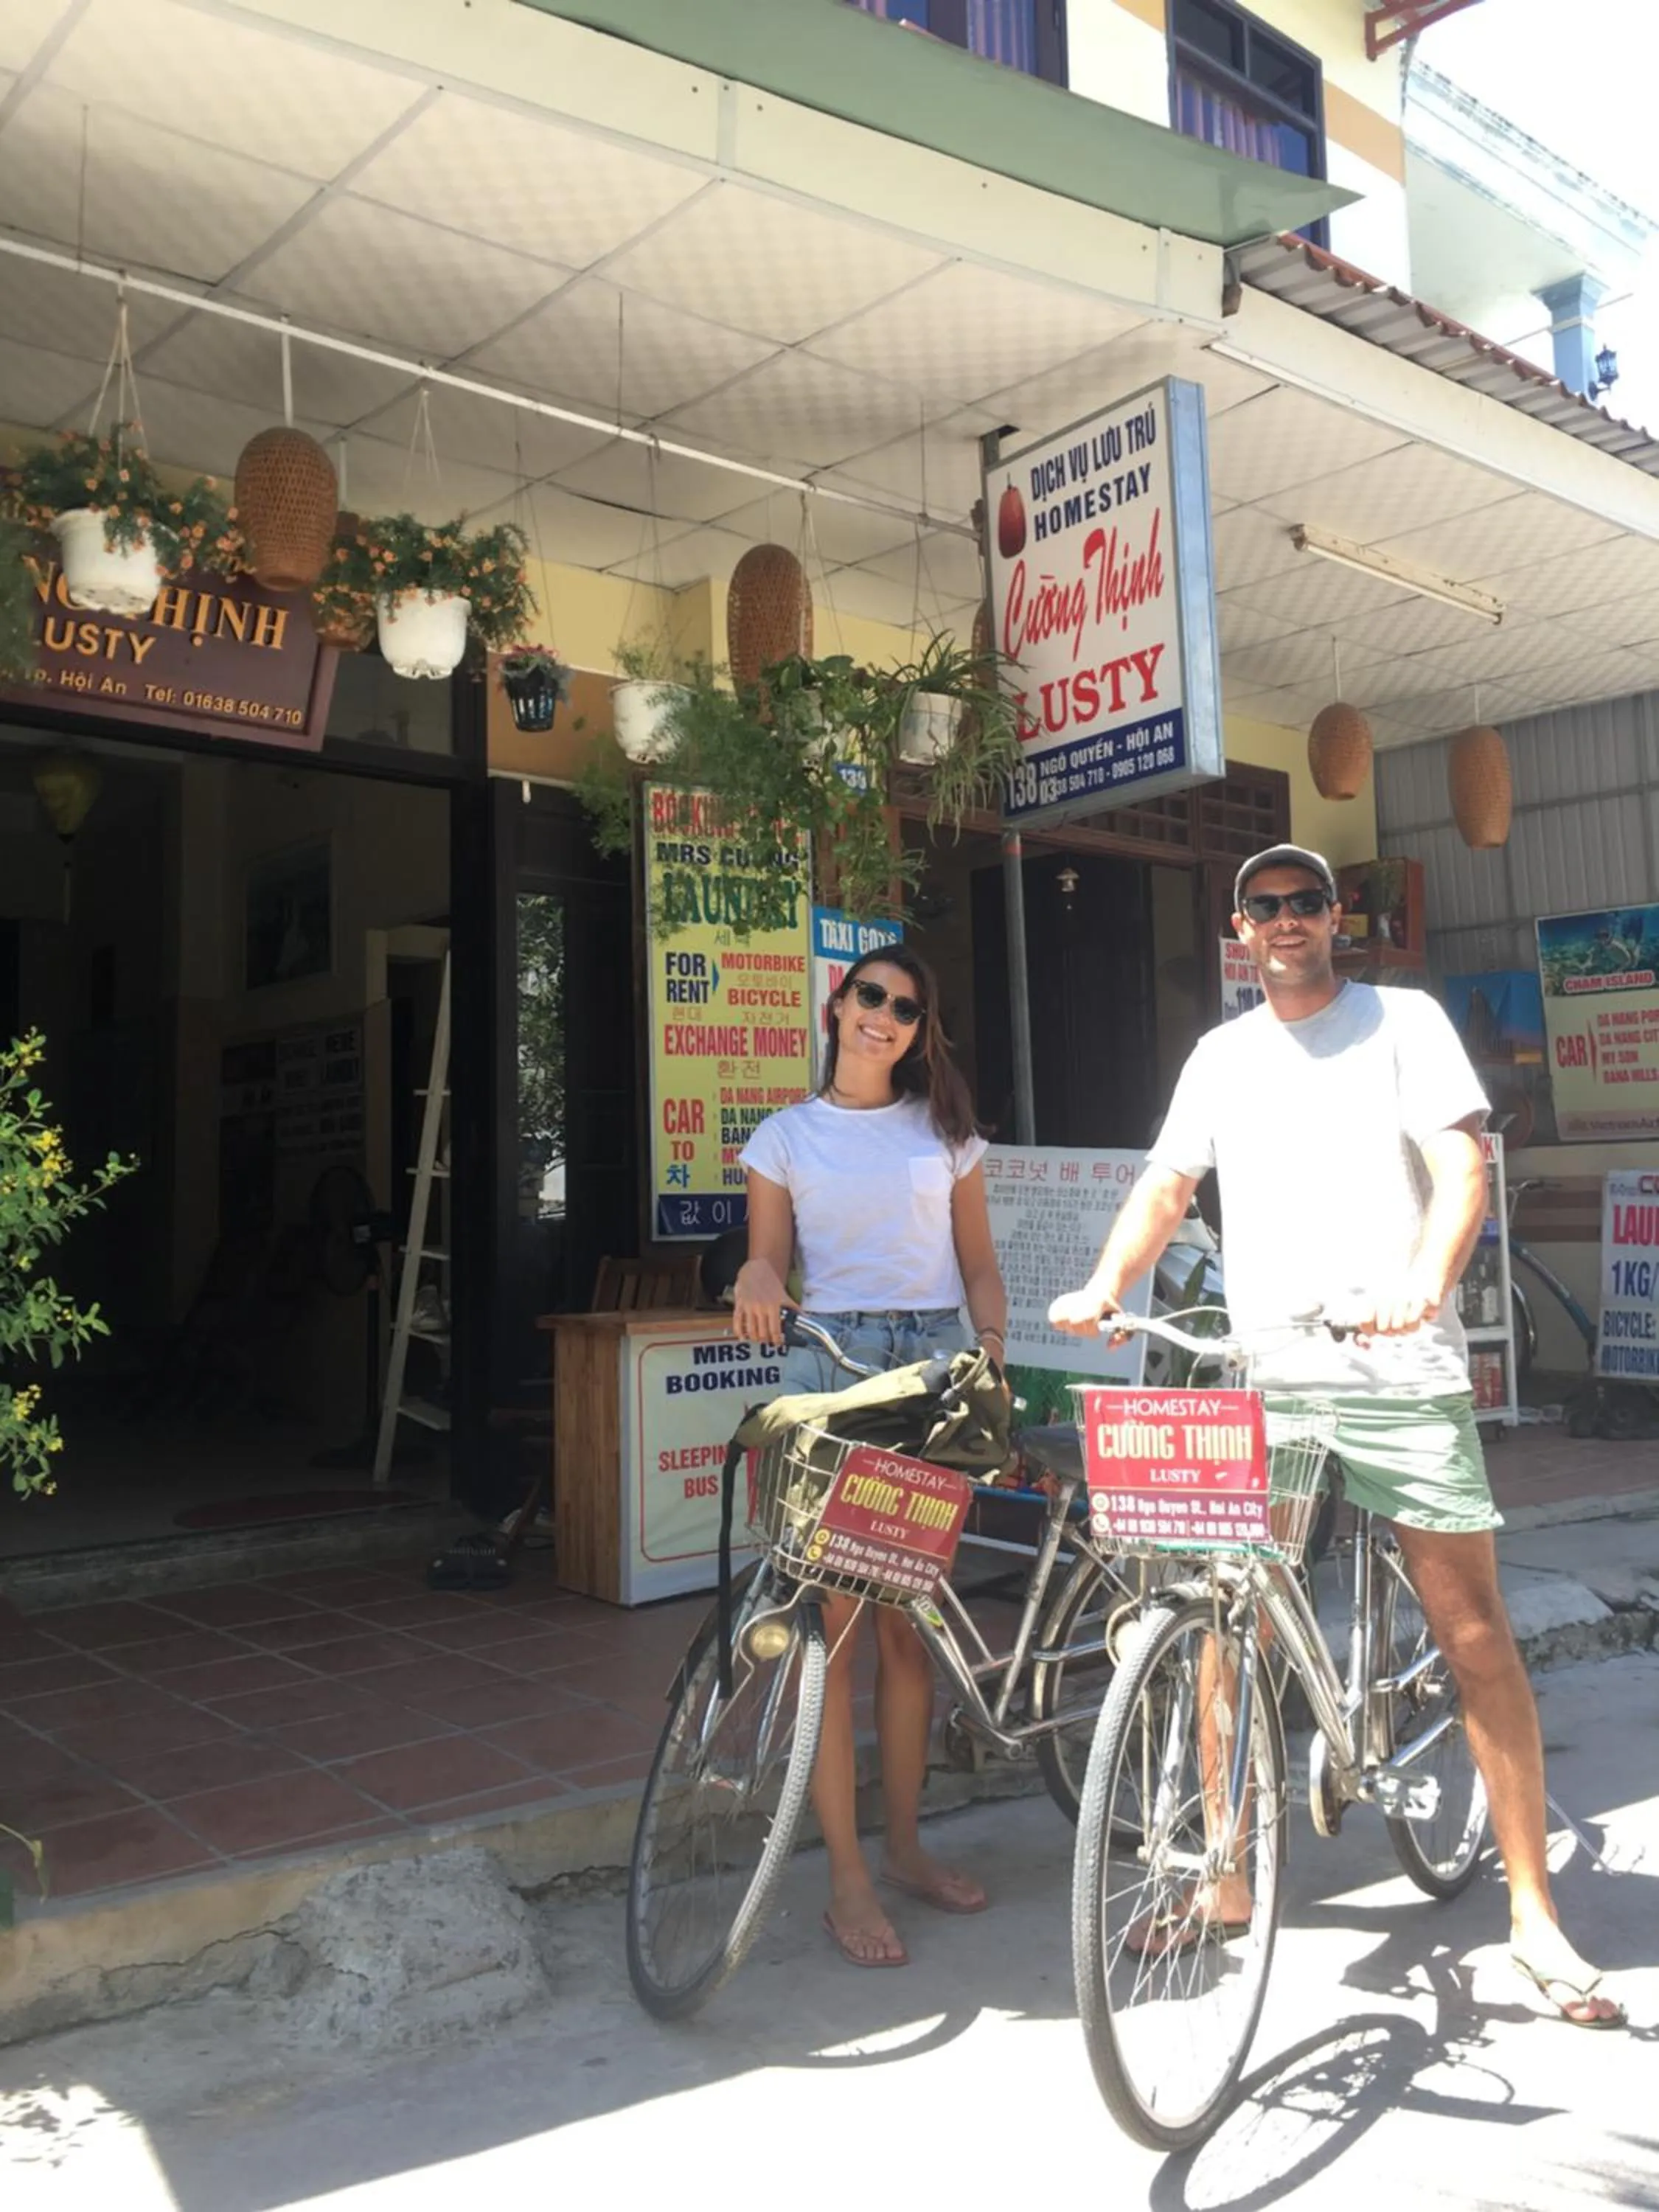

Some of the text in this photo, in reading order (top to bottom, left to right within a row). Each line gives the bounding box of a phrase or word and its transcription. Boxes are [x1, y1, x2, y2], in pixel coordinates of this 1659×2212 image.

[1030, 402, 1156, 502] DỊCH VỤ LƯU TRÚ
[1034, 462, 1151, 542] HOMESTAY
[1082, 507, 1164, 632] Thịnh
[127, 585, 290, 650] HỊNH
[28, 615, 156, 665] USTY
[61, 669, 92, 692] Hội
[100, 677, 127, 695] An
[145, 684, 176, 703] Tel:
[184, 692, 234, 714] 01638
[239, 700, 270, 720] 504
[273, 706, 302, 726] 710
[1013, 643, 1165, 743] LUSTY
[1153, 721, 1174, 742] AN
[656, 841, 711, 865] MRS
[820, 919, 853, 953] TAXI
[665, 952, 706, 977] FOR
[721, 953, 806, 973] MOTORBIKE
[667, 979, 709, 1004] RENT
[727, 988, 801, 1007] BICYCLE
[664, 1023, 807, 1058] EXCHANGE MONEY
[1556, 1035, 1588, 1068] CAR
[663, 1098, 705, 1135] CAR
[721, 1108, 737, 1125] DA
[721, 1127, 752, 1145] BAN
[670, 1141, 695, 1161] TO
[666, 1164, 691, 1189] 차
[723, 1169, 748, 1187] HU
[984, 1158, 1135, 1186] 코코넛 배 투어
[693, 1343, 751, 1366] MRS
[666, 1366, 780, 1394] BOOKING
[1124, 1398, 1221, 1416] HOMESTAY
[658, 1444, 730, 1472] SLEEPIN
[684, 1475, 718, 1499] BUS
[874, 1458, 947, 1491] HOMESTAY
[1150, 1468, 1202, 1483] LUSTY
[1110, 1495, 1135, 1513] 138
[870, 1520, 910, 1540] LUSTY
